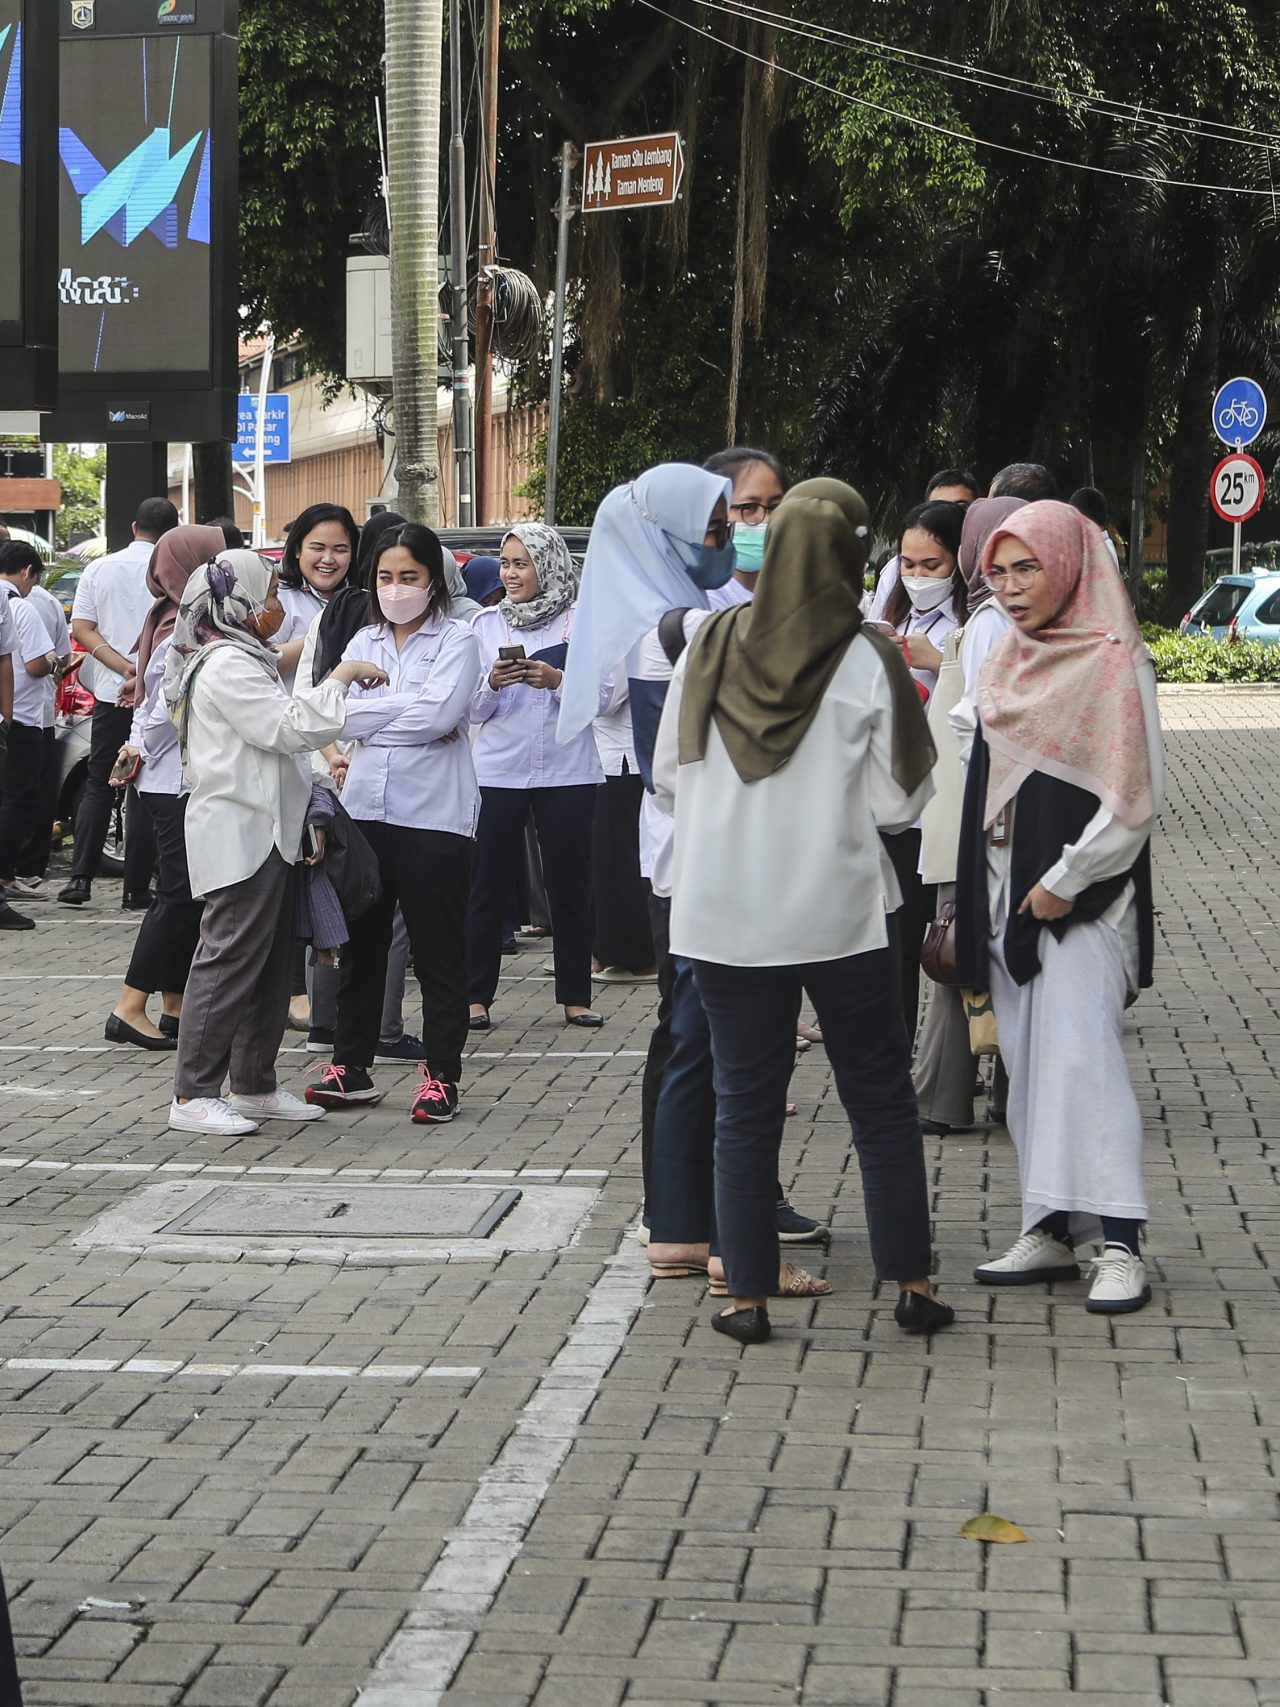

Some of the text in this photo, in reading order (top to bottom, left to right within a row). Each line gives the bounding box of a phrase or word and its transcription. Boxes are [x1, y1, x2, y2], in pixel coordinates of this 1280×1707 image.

[611, 147, 672, 169] Taman Situ Lembang
[617, 176, 664, 196] Taman Menteng
[248, 422, 277, 432] Par
[237, 434, 281, 446] emng
[1220, 472, 1255, 505] 25 km
